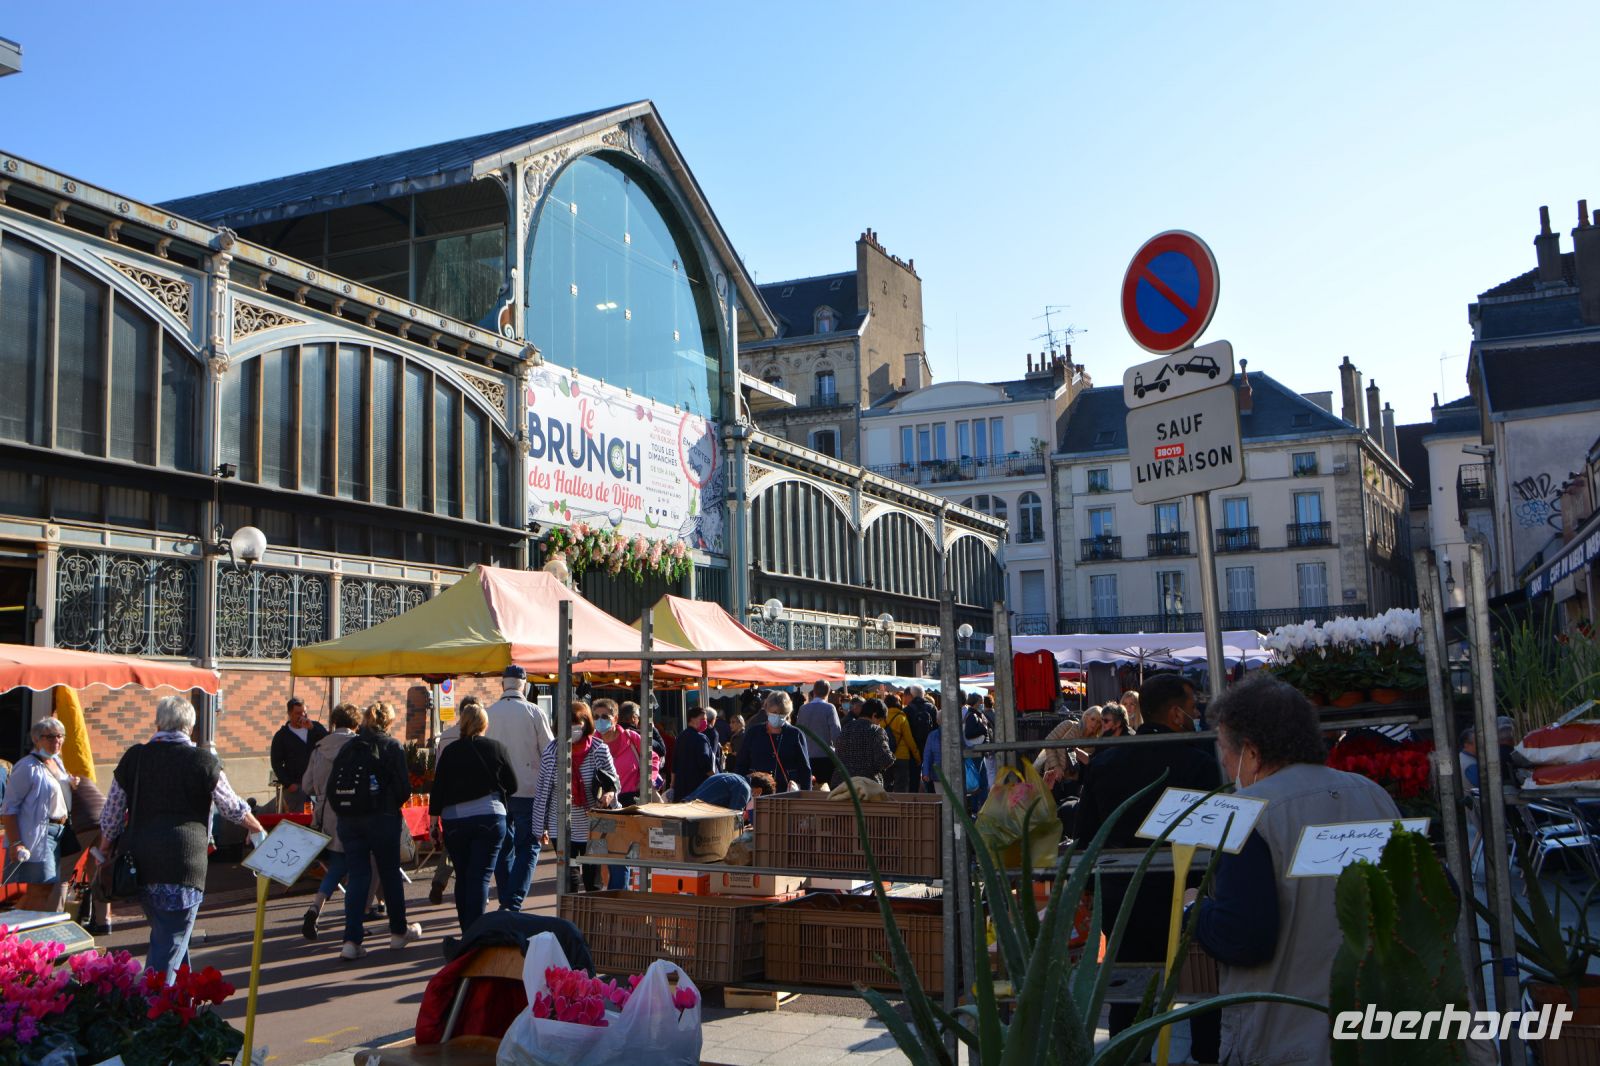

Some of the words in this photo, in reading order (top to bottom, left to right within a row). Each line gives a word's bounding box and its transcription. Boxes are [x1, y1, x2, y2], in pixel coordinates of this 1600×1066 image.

[579, 398, 595, 439] Le
[1156, 413, 1203, 441] SAUF
[528, 411, 642, 485] BRUNCH
[648, 451, 678, 467] DIMANCHES
[665, 447, 675, 457] LES
[1137, 445, 1233, 483] LIVRAISON
[528, 465, 550, 490] des
[554, 469, 593, 500] Halles
[595, 481, 609, 503] de
[612, 483, 642, 514] Dijon
